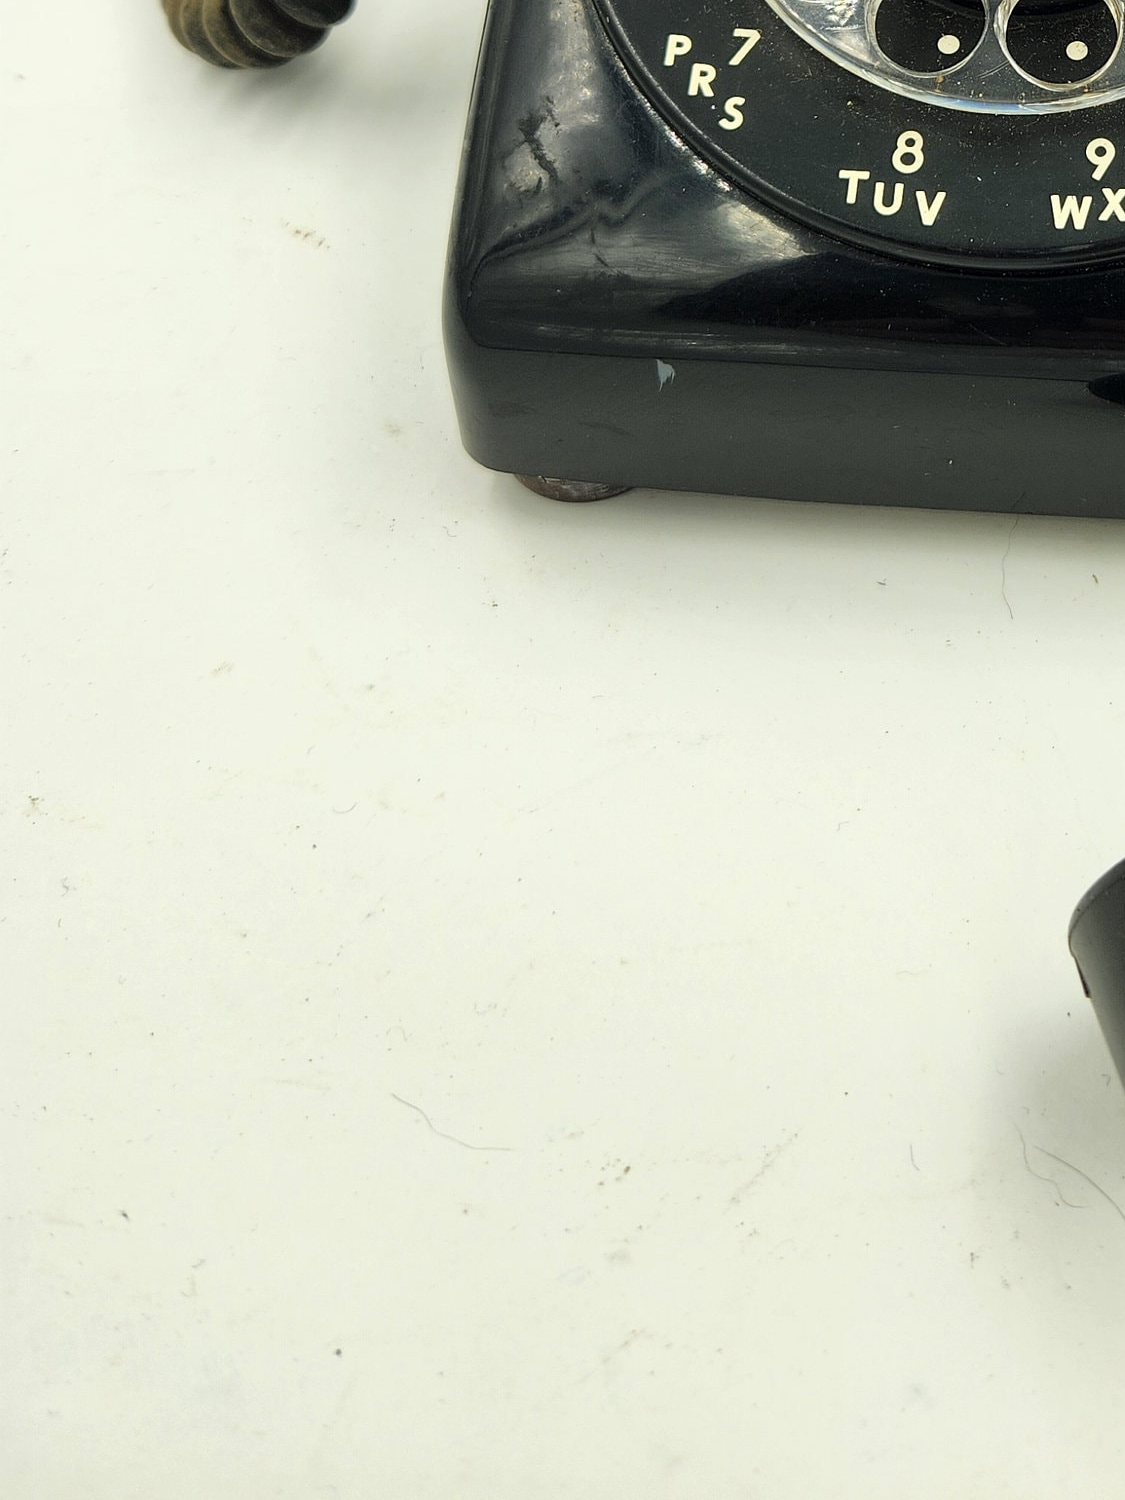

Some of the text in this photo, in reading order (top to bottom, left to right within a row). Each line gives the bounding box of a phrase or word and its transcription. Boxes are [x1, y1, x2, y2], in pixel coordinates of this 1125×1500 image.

[728, 27, 762, 66] 7
[891, 130, 925, 174] 8
[1085, 137, 1116, 181] 9
[838, 169, 947, 227] TUV
